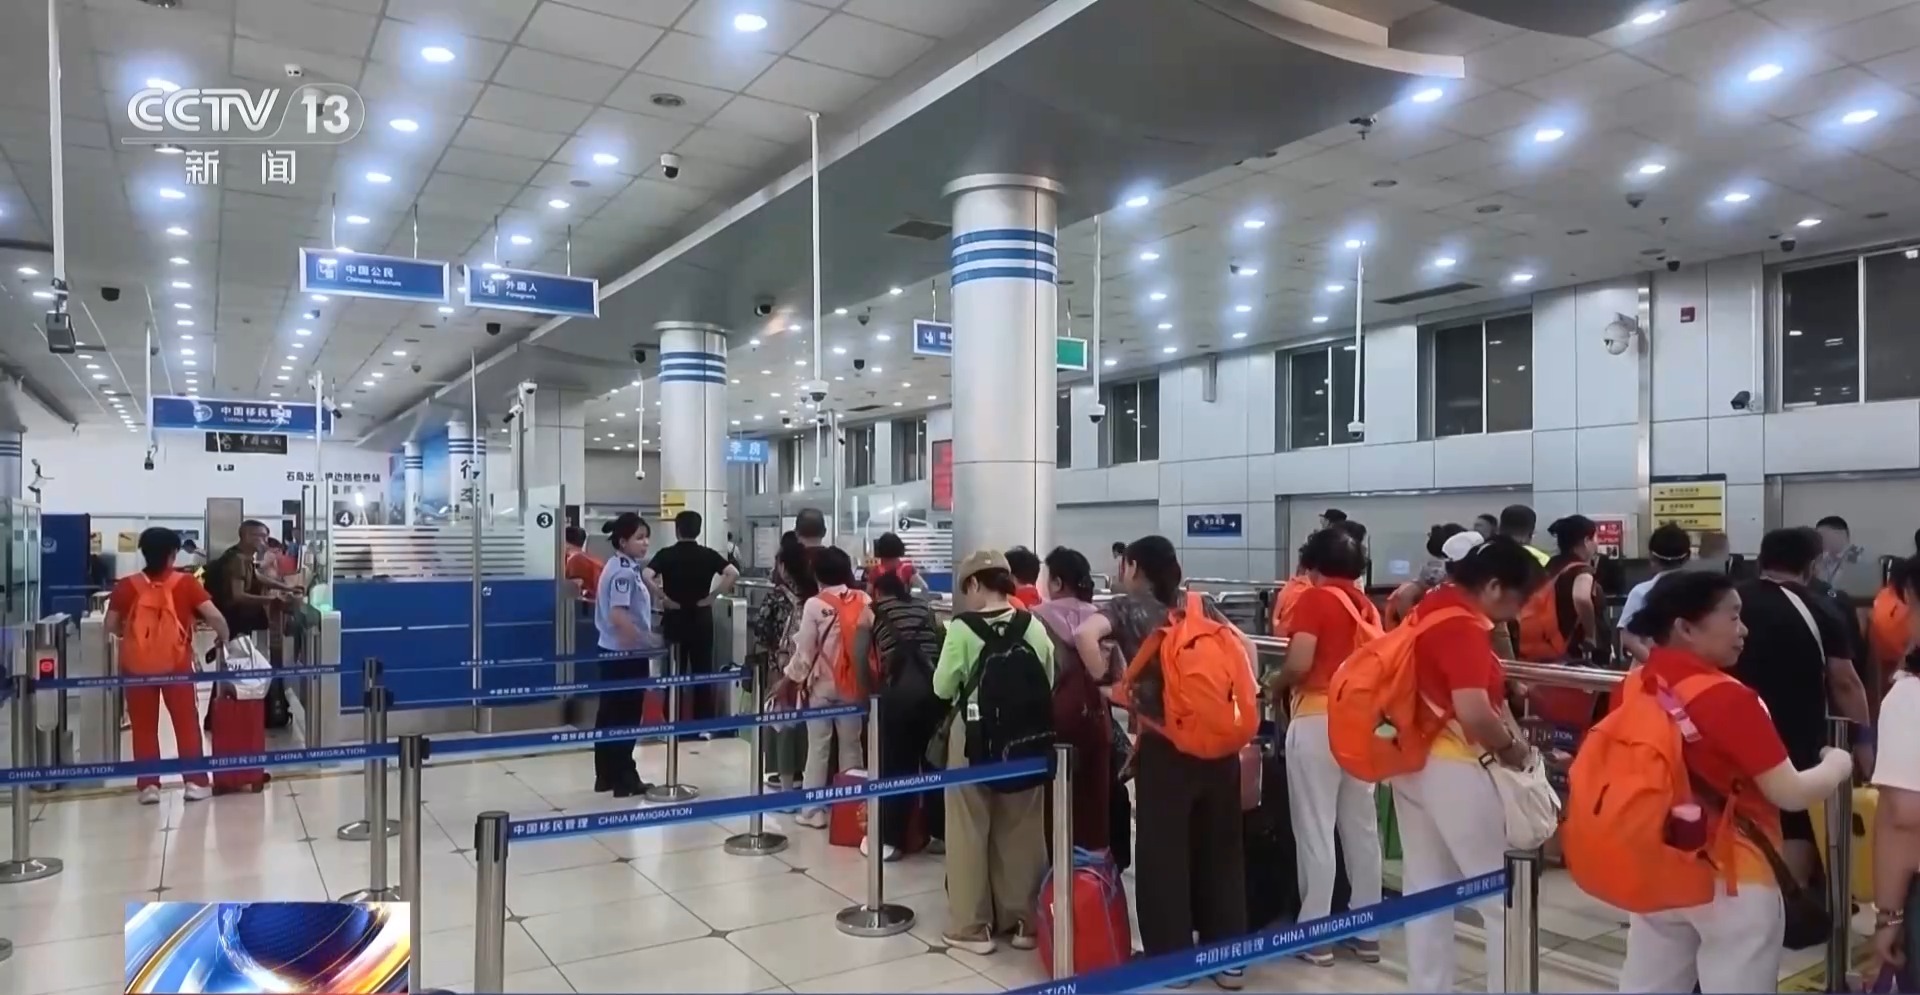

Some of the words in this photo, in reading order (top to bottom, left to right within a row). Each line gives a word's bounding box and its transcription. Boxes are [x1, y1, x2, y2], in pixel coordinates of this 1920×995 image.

[345, 264, 394, 279] 中国公民
[505, 280, 538, 293] 外国人
[220, 406, 293, 419] 中国移民管理
[286, 471, 381, 483] 石岛出境边防检查站
[340, 512, 350, 523] 4
[541, 514, 549, 526] 3
[901, 519, 908, 530] 2
[274, 752, 305, 762] CHINA
[306, 746, 367, 759] IMMIGRATION
[8, 771, 42, 780] CHINA
[44, 765, 115, 778] IMMIGRATION
[805, 785, 862, 800] 中国移民管理
[868, 782, 893, 792] CHINA
[892, 773, 942, 788] IMMIGRATION
[513, 816, 589, 836] 中国移民管理
[598, 814, 630, 827] CHINA
[629, 806, 693, 823] IMMIGRATION
[1272, 927, 1305, 947] CHINA
[1308, 910, 1375, 939] IMMIGRATION
